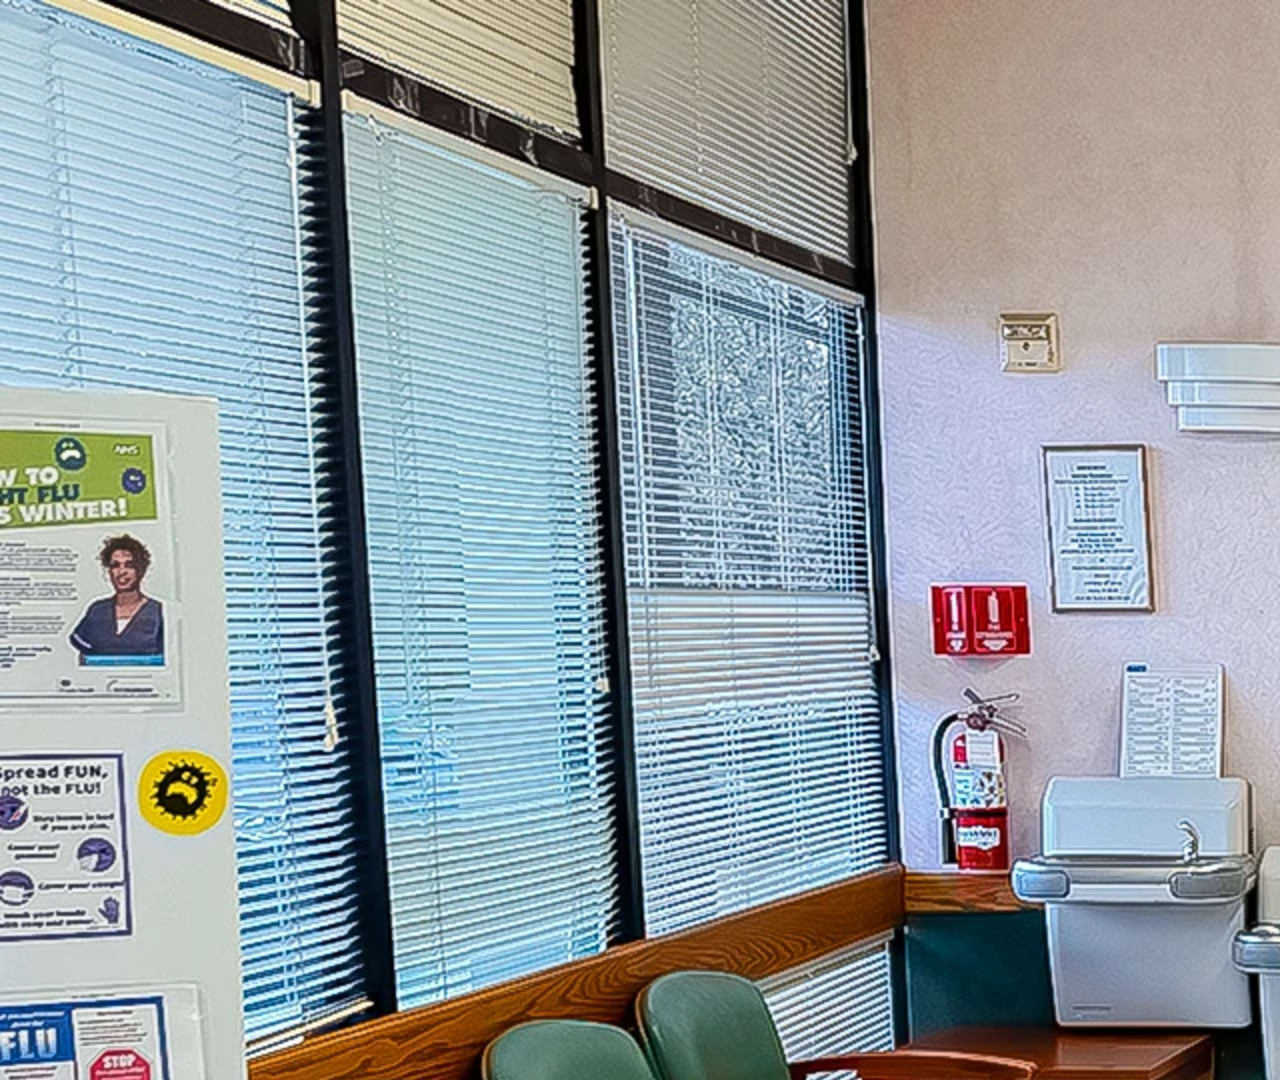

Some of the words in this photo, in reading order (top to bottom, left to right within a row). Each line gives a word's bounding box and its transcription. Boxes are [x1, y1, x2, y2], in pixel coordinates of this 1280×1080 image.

[25, 466, 60, 486] TO
[38, 484, 80, 504] FLU
[18, 496, 127, 523] WINTER!
[0, 765, 59, 781] pread
[64, 765, 108, 779] FUN,
[1, 785, 28, 796] not
[33, 783, 61, 795] the
[65, 782, 100, 795] FLU!
[0, 1026, 57, 1061] FLU
[102, 1053, 137, 1069] STOP
